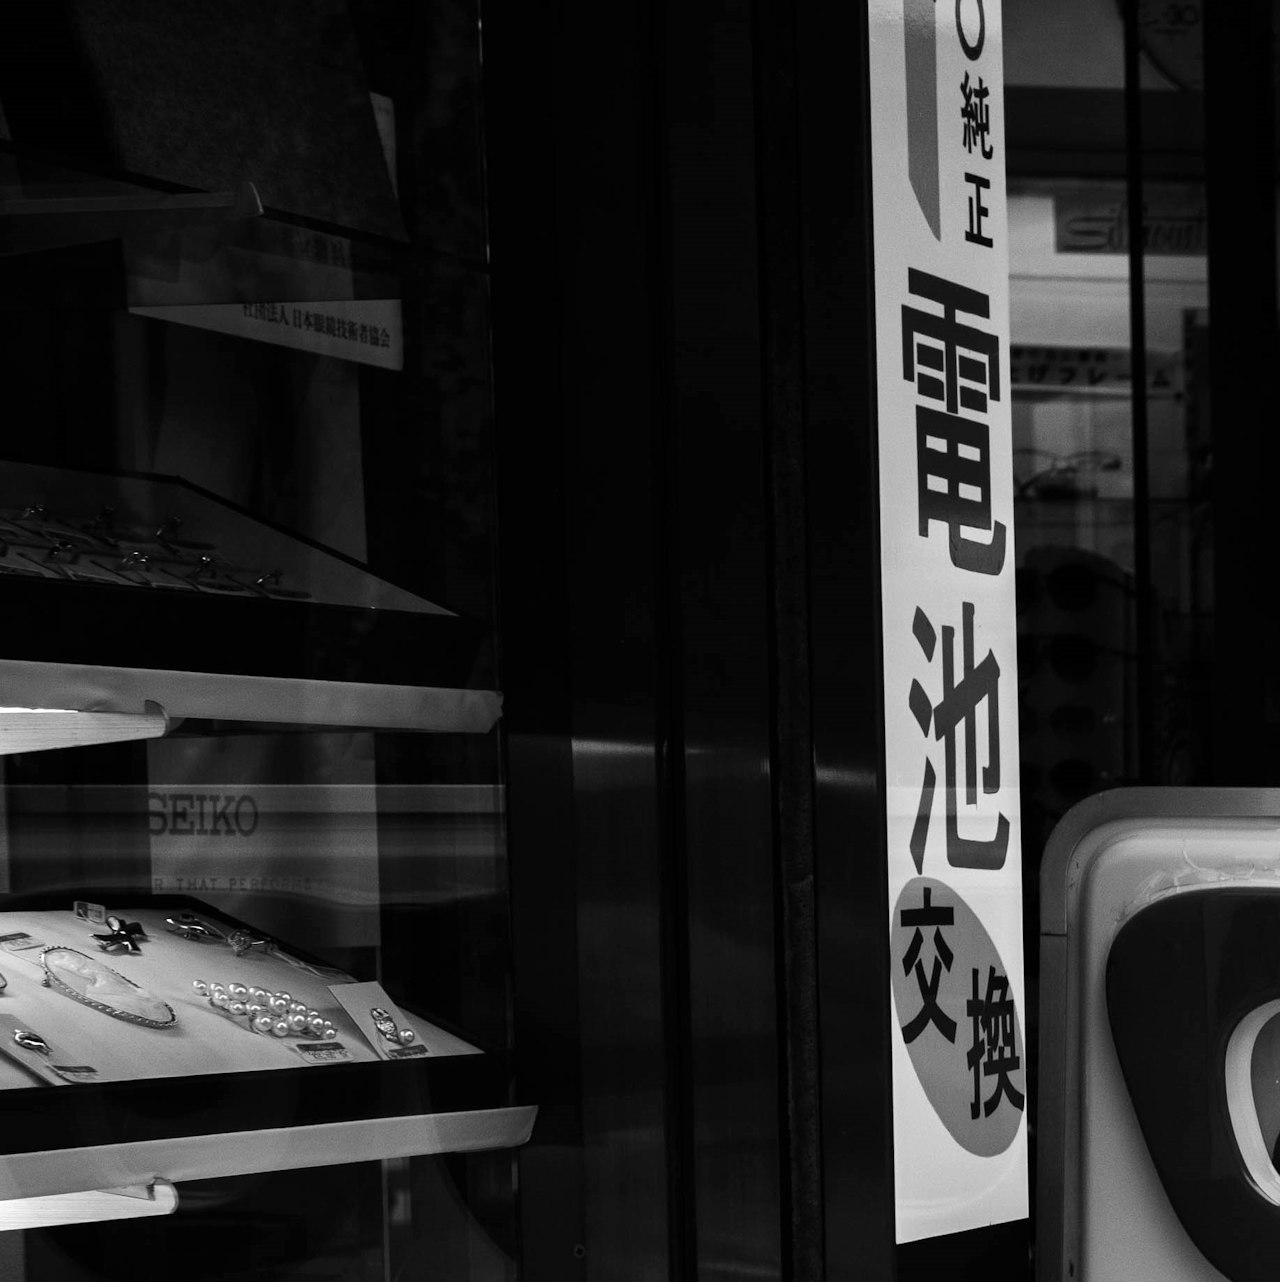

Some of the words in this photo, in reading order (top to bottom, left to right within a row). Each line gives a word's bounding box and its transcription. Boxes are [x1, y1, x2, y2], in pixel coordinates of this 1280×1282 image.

[901, 266, 1011, 875] 電池
[148, 793, 258, 837] SEIKO
[901, 886, 1024, 1119] 交換
